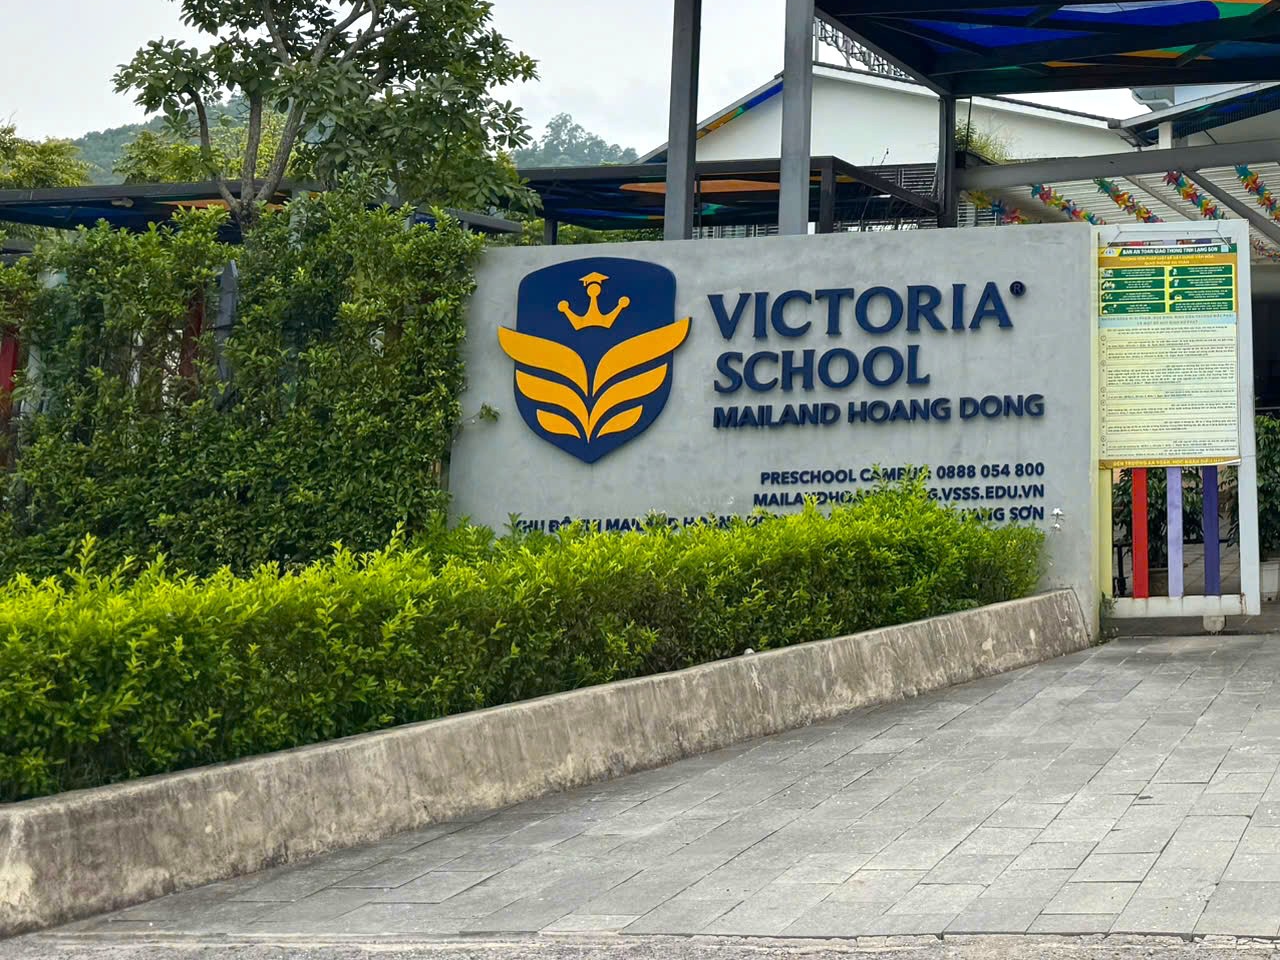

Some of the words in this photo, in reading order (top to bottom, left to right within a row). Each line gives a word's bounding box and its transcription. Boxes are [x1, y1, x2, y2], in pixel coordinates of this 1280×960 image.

[714, 344, 931, 392] SCHOOL
[713, 402, 841, 428] MAILAND
[848, 397, 951, 423] HOANG
[959, 393, 1045, 419] DONG
[760, 470, 857, 485] PRESCHOOL
[936, 465, 977, 480] 0888
[980, 464, 1011, 478] 054
[1014, 462, 1045, 477] 800
[1009, 504, 1045, 520] SƠN
